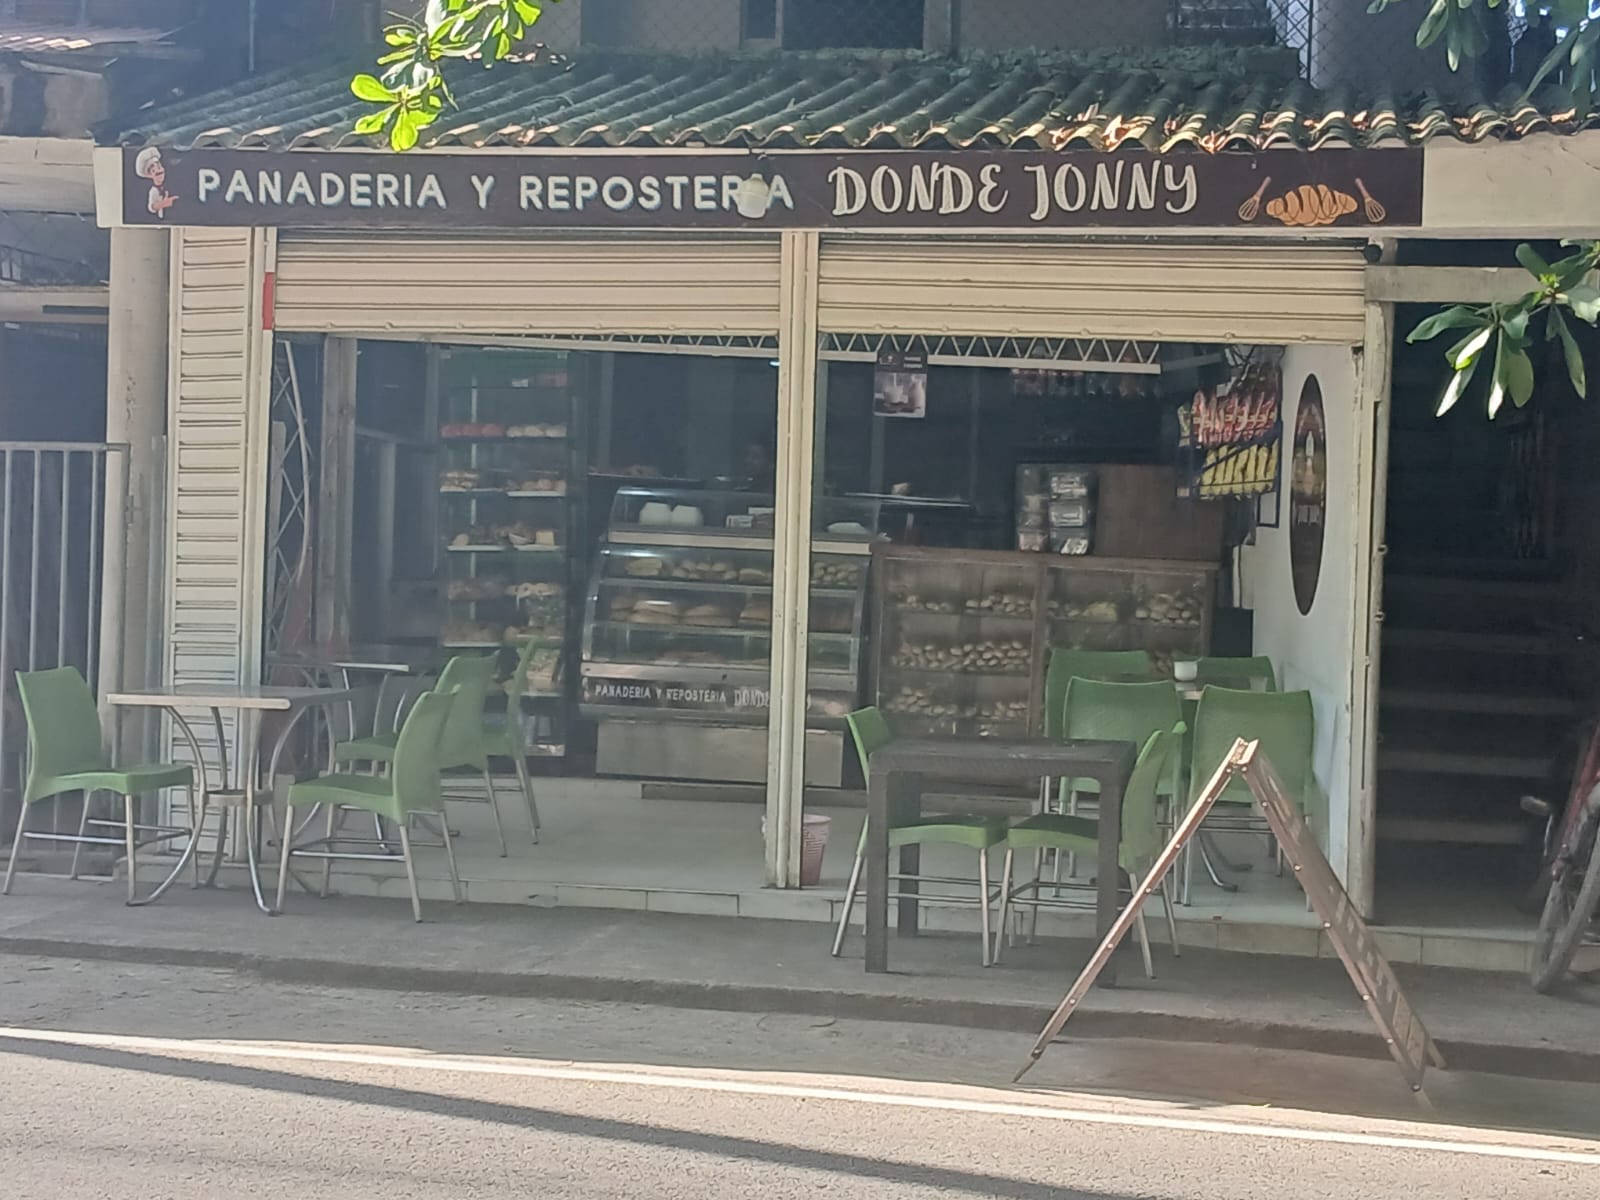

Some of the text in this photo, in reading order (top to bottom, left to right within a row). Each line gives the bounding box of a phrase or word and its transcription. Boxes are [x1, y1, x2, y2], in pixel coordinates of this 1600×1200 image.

[198, 158, 1198, 221] PANADERIA Y REPOSTERA DONDE JONNY
[594, 684, 651, 698] PANADERIA
[656, 687, 663, 700] Y
[665, 688, 727, 703] REPOSTERIA
